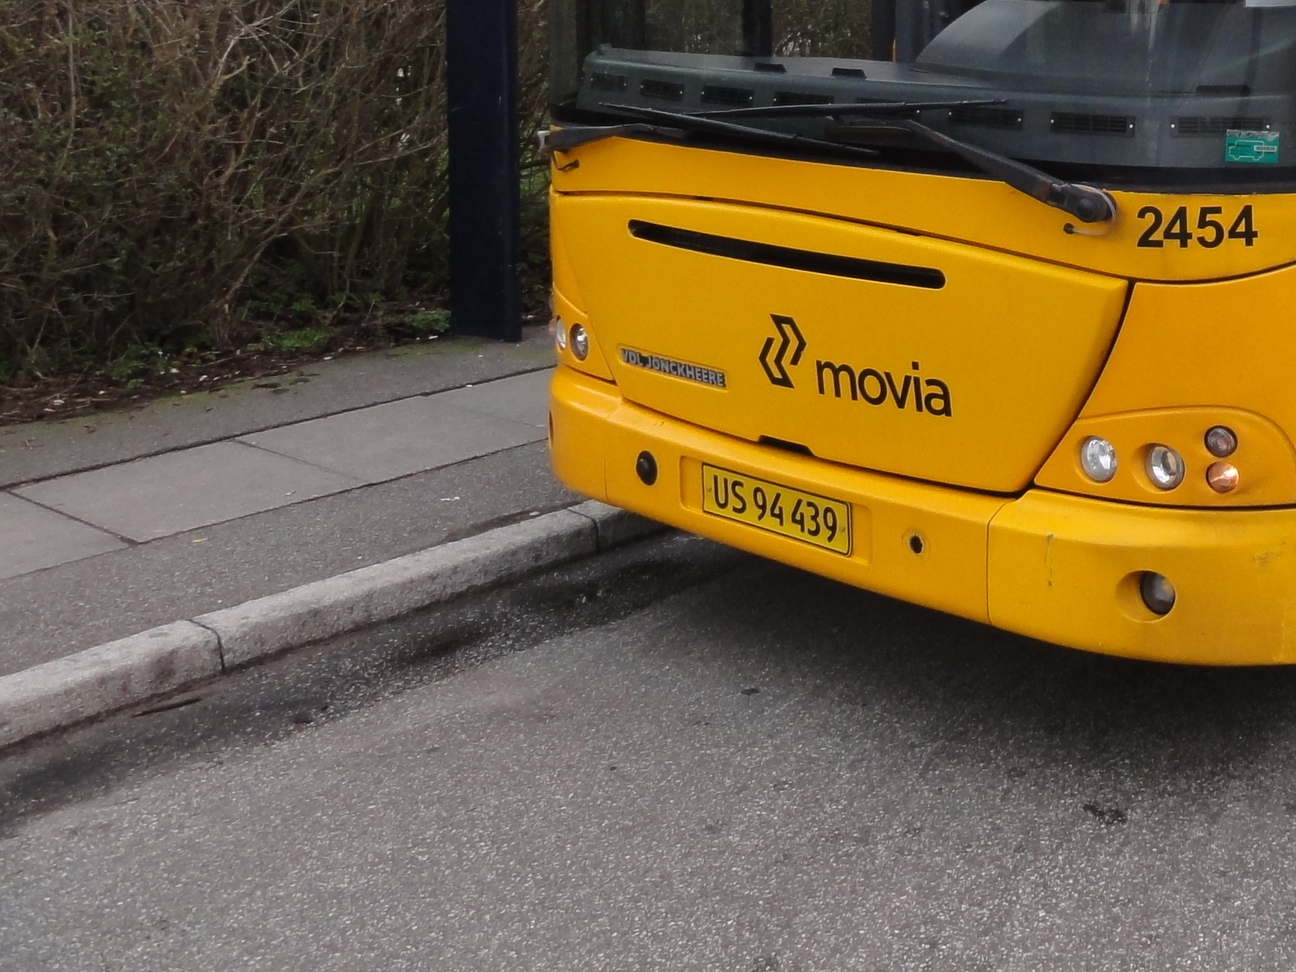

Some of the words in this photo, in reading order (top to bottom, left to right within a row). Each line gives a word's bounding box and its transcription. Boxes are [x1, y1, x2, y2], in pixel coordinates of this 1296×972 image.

[1137, 205, 1258, 248] 2454
[645, 355, 724, 387] JONCKHEERE
[815, 360, 952, 417] movia
[713, 474, 747, 514] US
[752, 486, 784, 527] 94
[790, 498, 838, 543] 439
